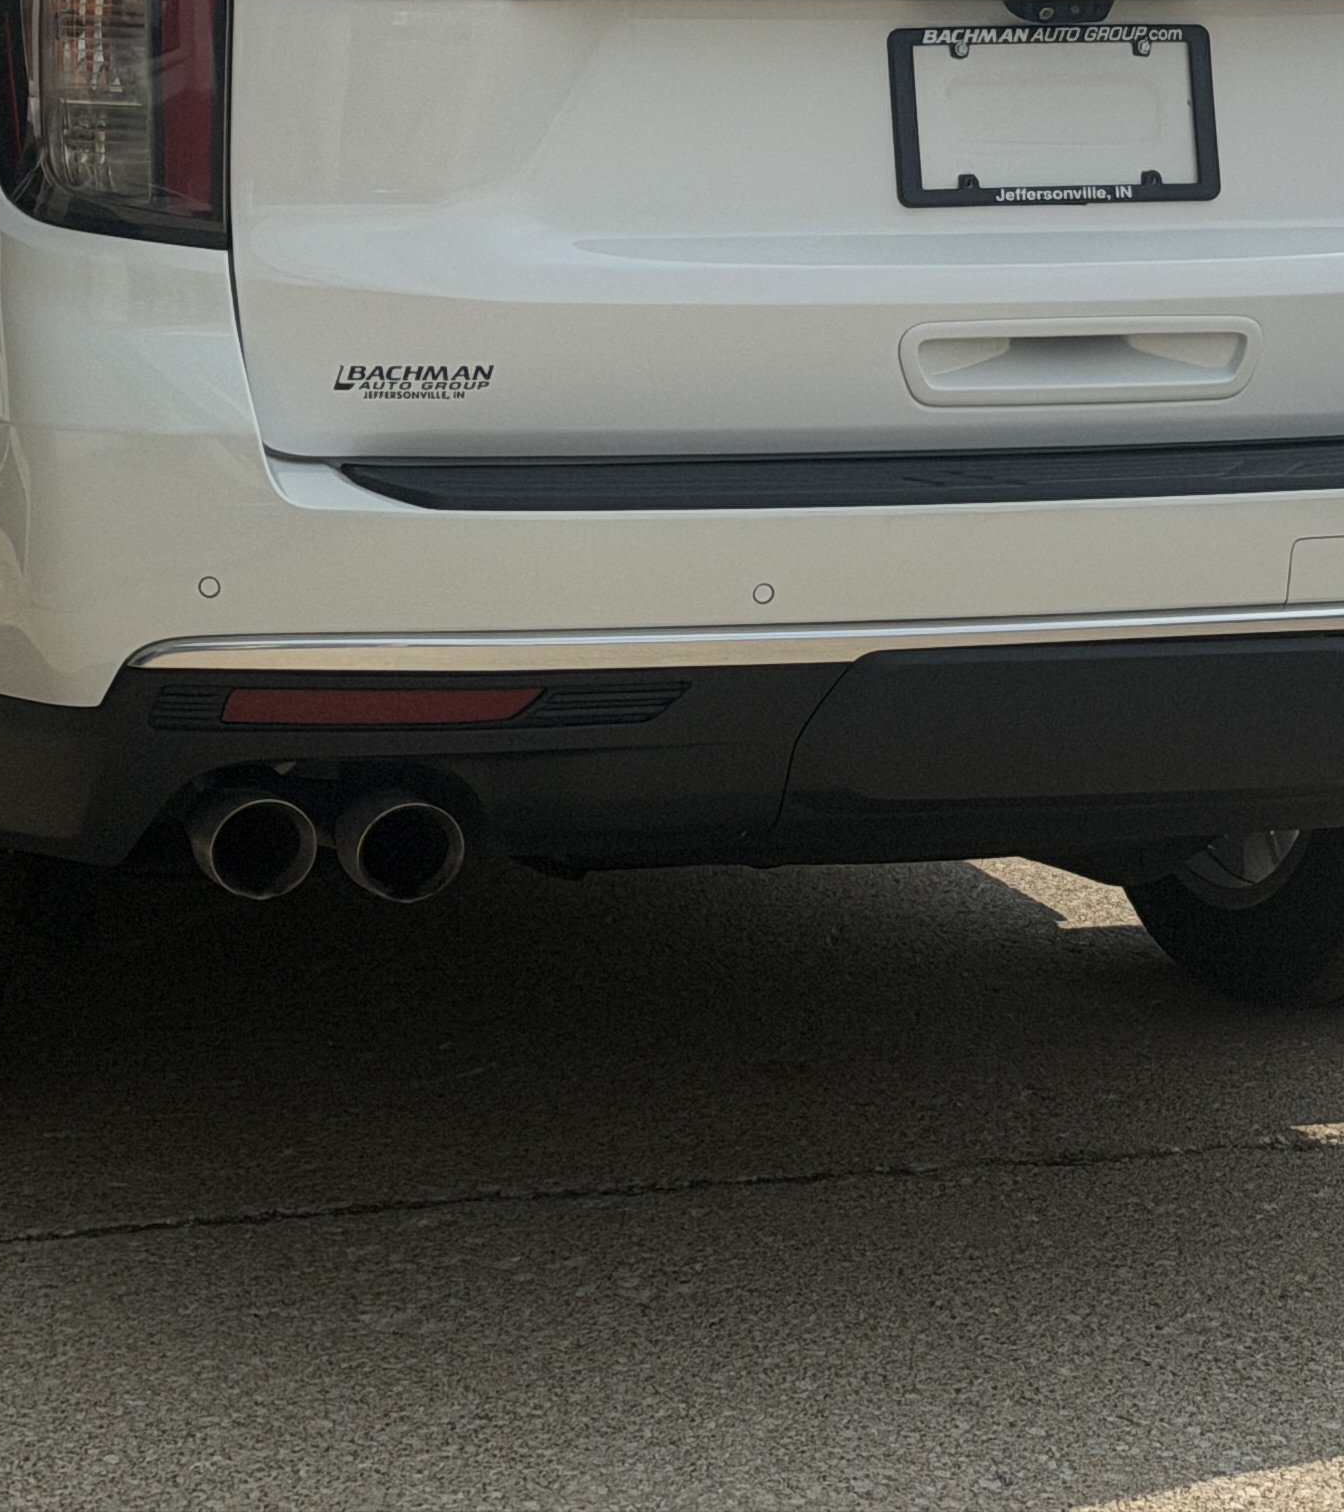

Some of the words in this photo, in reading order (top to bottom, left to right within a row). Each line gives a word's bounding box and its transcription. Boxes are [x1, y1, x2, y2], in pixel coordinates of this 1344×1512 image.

[922, 28, 1029, 43] BACHMAN
[1030, 27, 1080, 42] AUTO
[996, 187, 1111, 201] Jeffersonville,
[1115, 186, 1133, 199] IN
[347, 365, 494, 381] BACHMAN
[358, 381, 412, 390] AUTO
[421, 381, 490, 391] GROUP
[453, 391, 465, 399] IN
